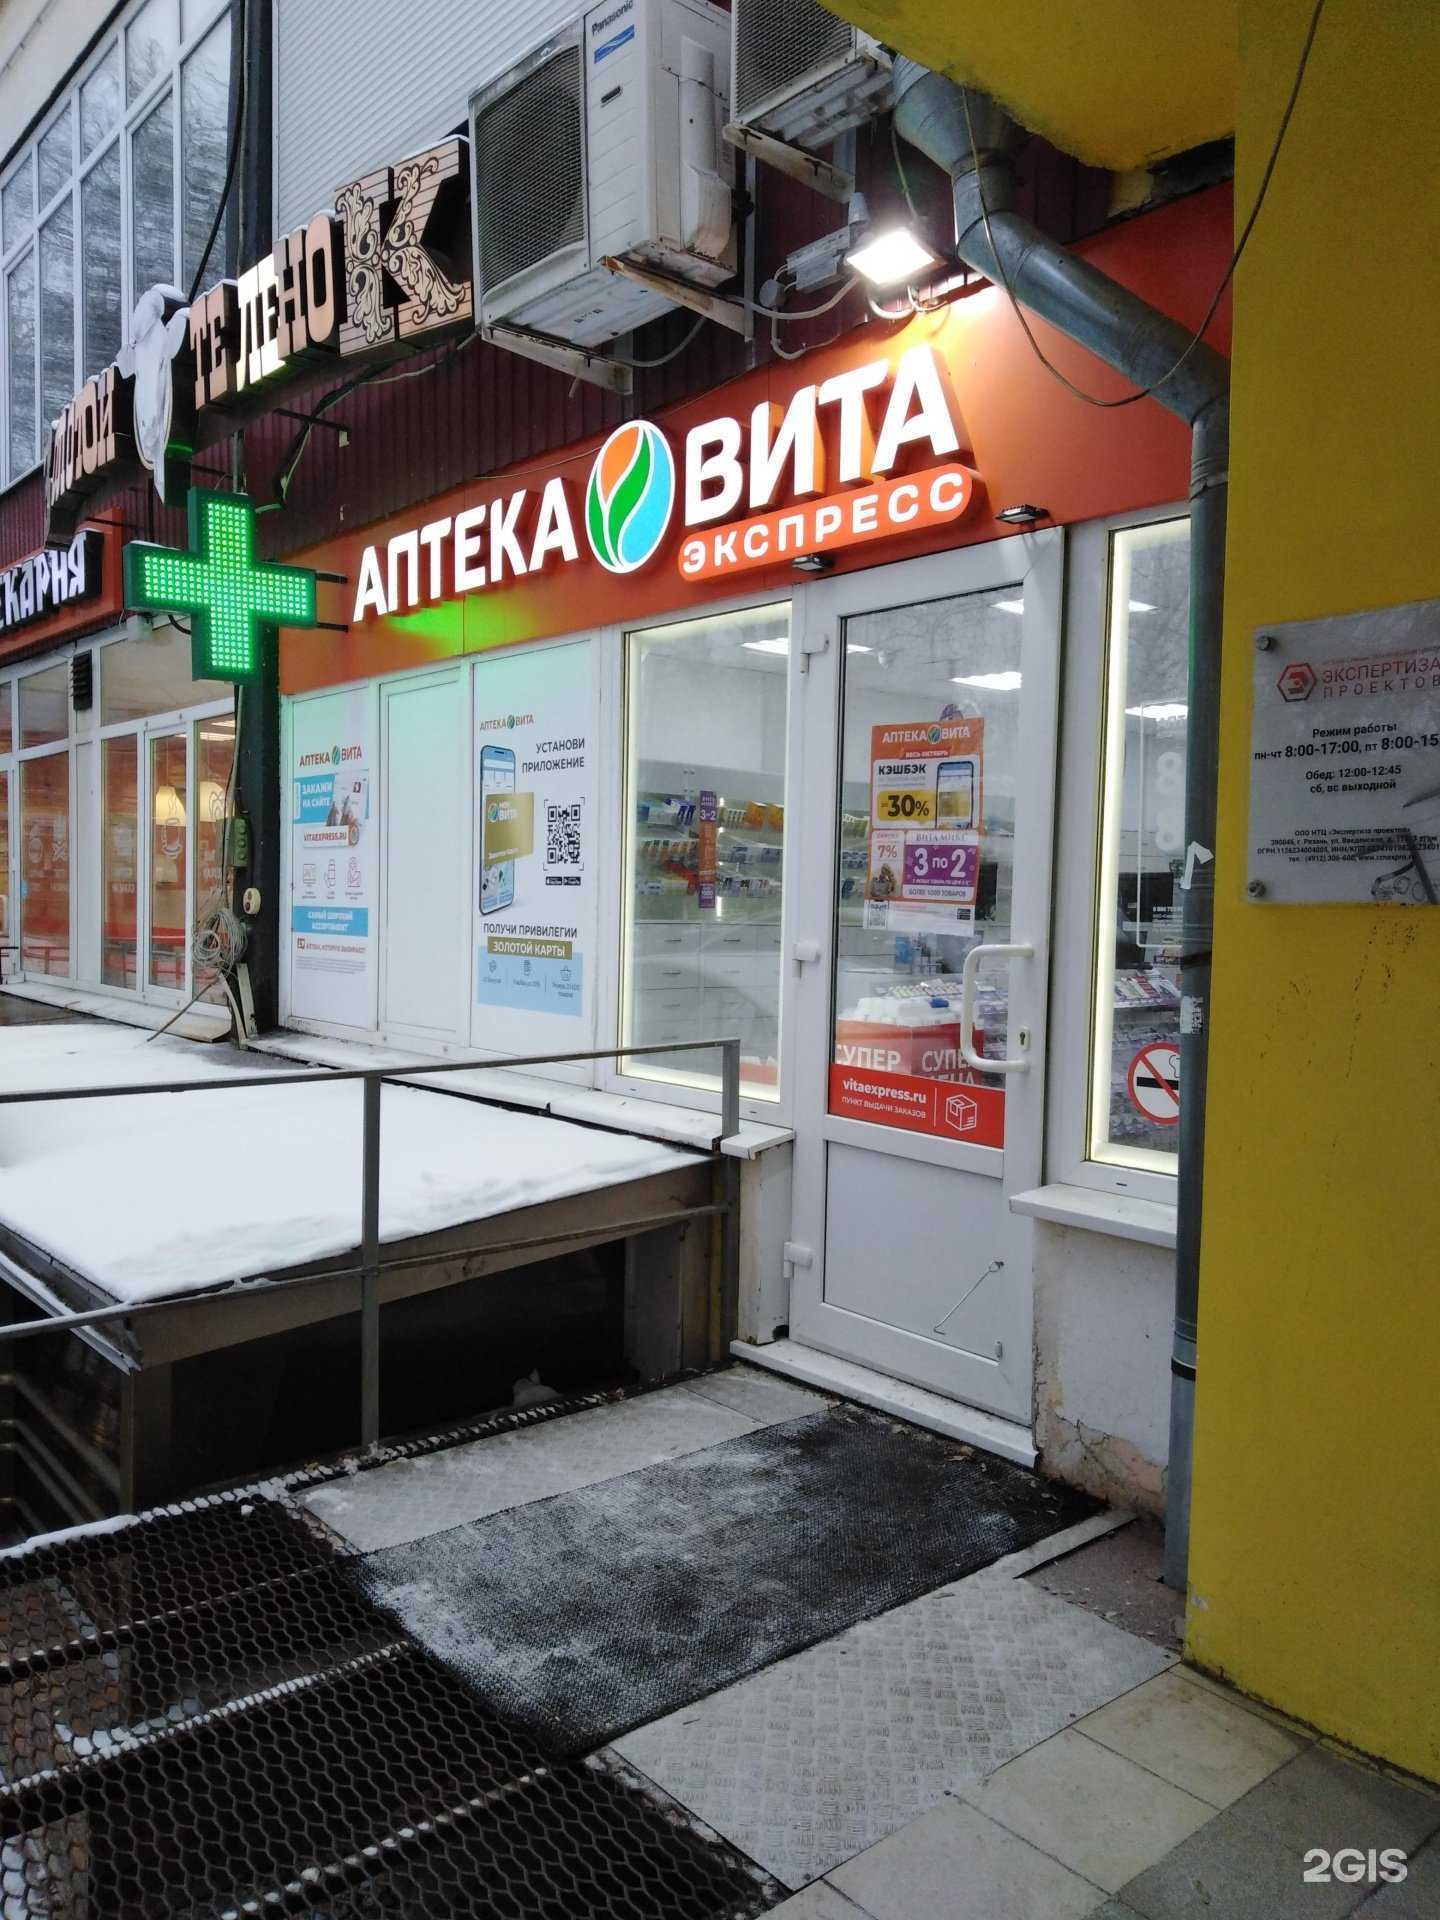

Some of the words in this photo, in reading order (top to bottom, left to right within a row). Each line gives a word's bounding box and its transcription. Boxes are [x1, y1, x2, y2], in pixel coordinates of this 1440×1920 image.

[592, 0, 633, 36] Panasonic
[190, 137, 473, 411] ТЕЛЕНОК
[352, 476, 580, 623] АПТЕКА
[684, 342, 962, 527] ВИТА
[682, 471, 966, 573] ЭКСПРЕСС
[1322, 659, 1440, 683] ЭКСПЕРТИЗА
[1323, 674, 1440, 698] ПРОЕКТОВ
[480, 718, 506, 730] АПТЕКА
[515, 714, 534, 726] ВИТА
[1313, 727, 1350, 739] Режим
[1353, 723, 1397, 737] работы
[882, 730, 928, 744] АПТЕКА
[941, 726, 971, 739] ВИТА
[299, 752, 330, 767] АПТЕКА
[341, 745, 362, 761] ВИТА
[536, 738, 585, 754] УСТАНОВИ
[1254, 750, 1282, 760] пн-чт
[1285, 740, 1362, 757] 8:00-17:00,
[1365, 743, 1378, 753] пт
[522, 757, 585, 773] ПРИЛОЖЕНИЕ
[878, 763, 927, 776] КЭШБЭК
[1305, 770, 1335, 781] Обед:
[1339, 765, 1402, 779] 12:00-12:45
[1327, 784, 1339, 793] вс
[1341, 780, 1397, 792] выходной
[914, 848, 929, 877] 3
[932, 857, 948, 869] по
[950, 848, 966, 878] 2
[483, 922, 517, 935] ПОЛУЧИ
[519, 925, 577, 938] ПРИВИЛЕГИИ
[493, 940, 532, 954] ЗОЛОТОЙ
[534, 945, 566, 957] КАРТЫ
[922, 1049, 972, 1072] СУПЕ
[842, 1078, 927, 1104] vitaexpress.ru
[841, 1096, 863, 1106] ПУНКТ
[864, 1100, 893, 1112] ВЫДАЧИ
[894, 1106, 927, 1119] ЗАКАЗОВ
